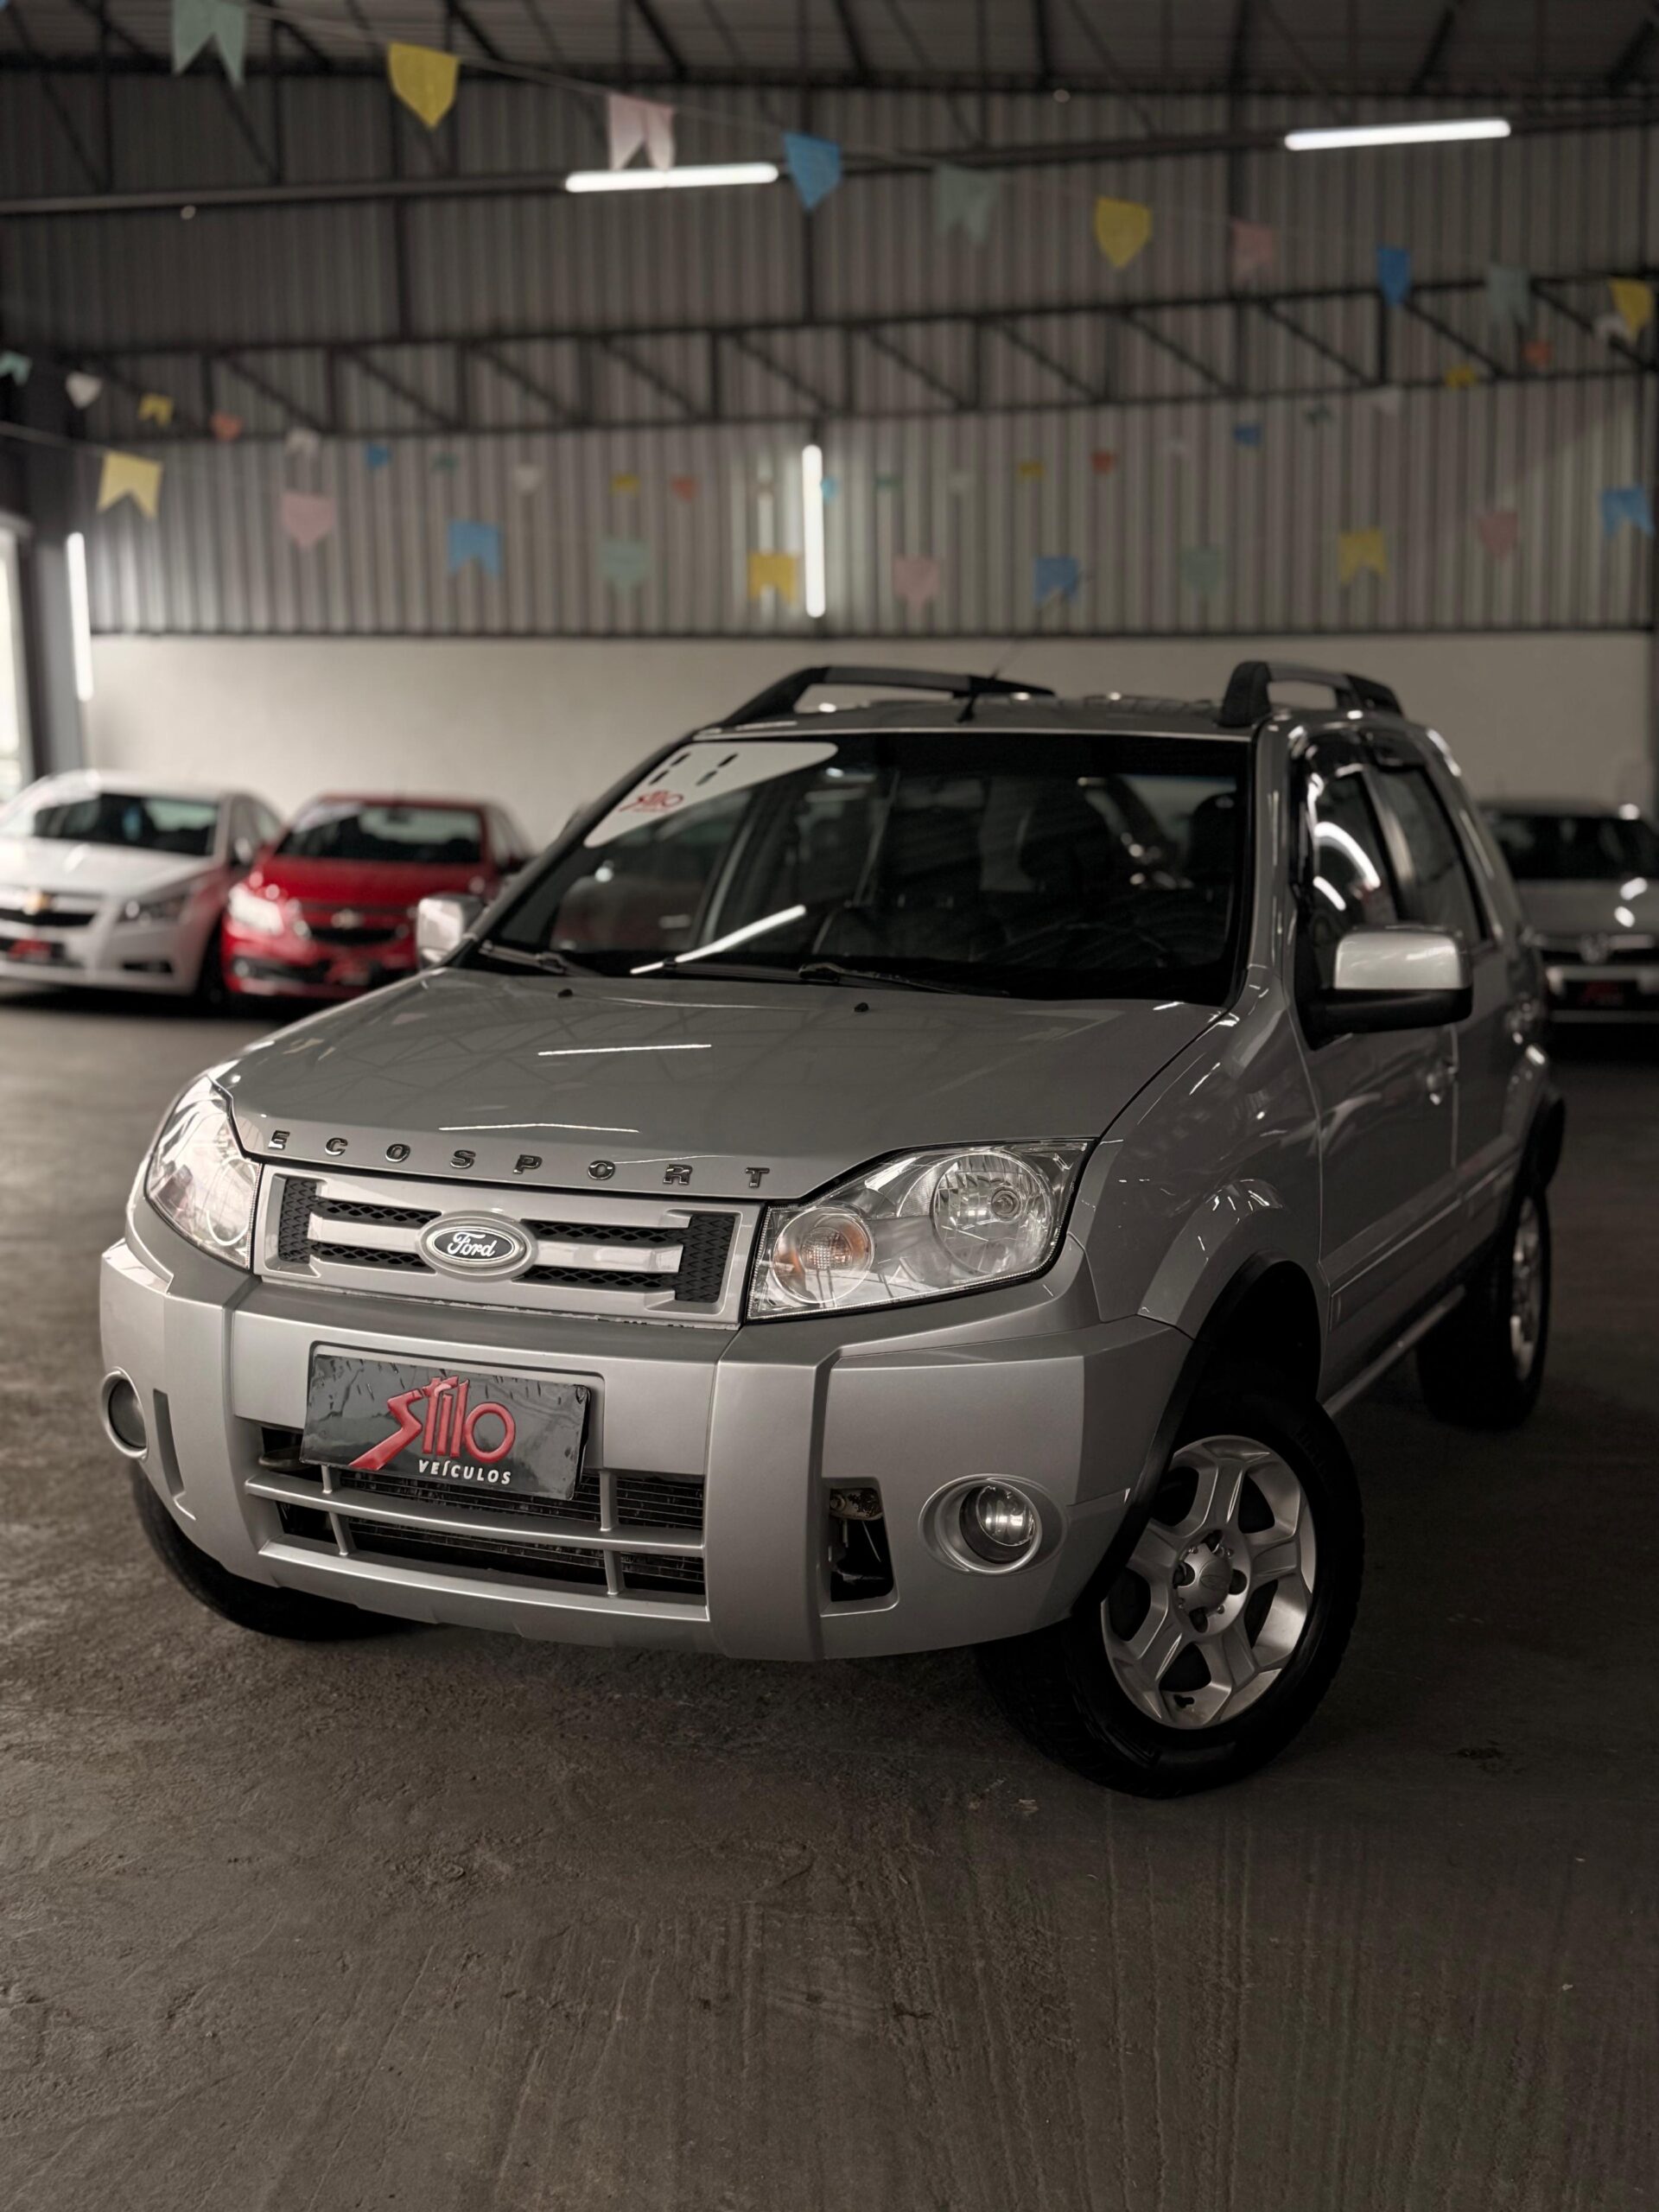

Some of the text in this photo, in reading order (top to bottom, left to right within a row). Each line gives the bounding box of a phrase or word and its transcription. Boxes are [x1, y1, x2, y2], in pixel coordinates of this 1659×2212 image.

[268, 1130, 770, 1188] ECOSPORT
[447, 1231, 498, 1257] Ford
[418, 1459, 512, 1485] VEÍCULOS
